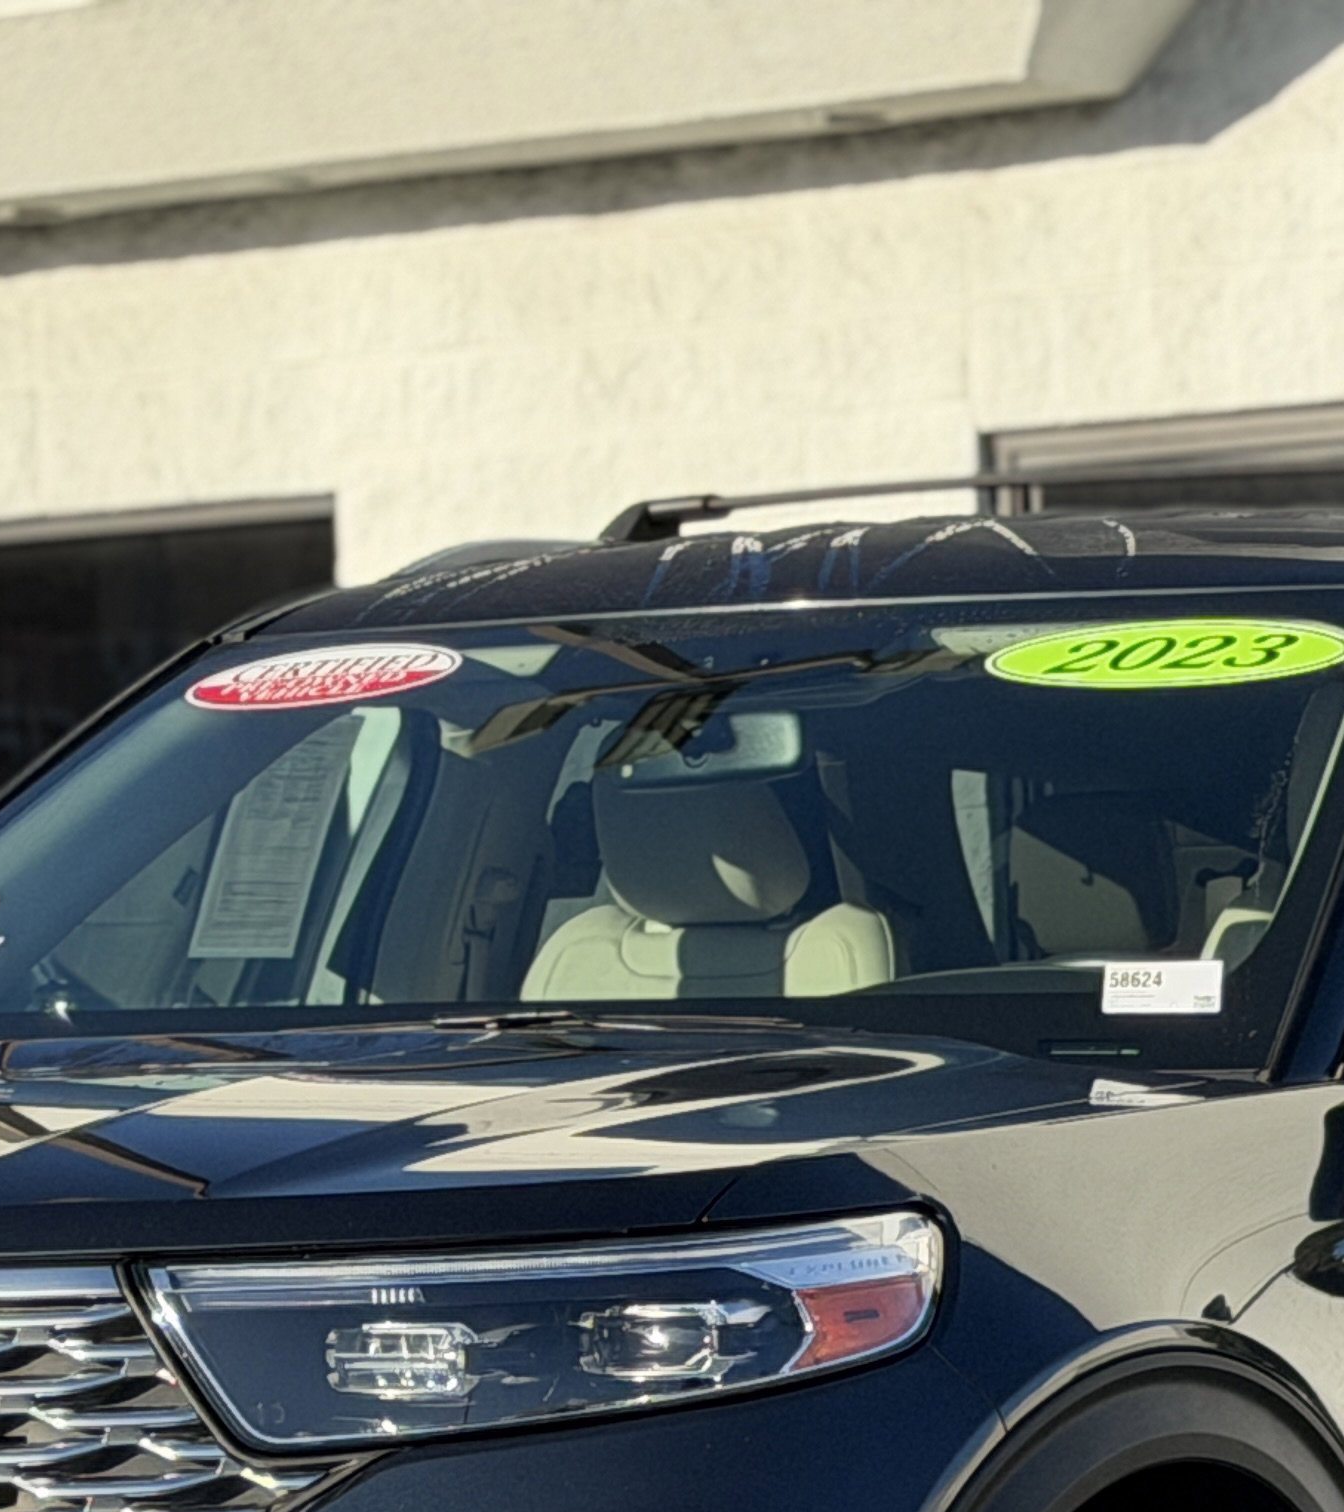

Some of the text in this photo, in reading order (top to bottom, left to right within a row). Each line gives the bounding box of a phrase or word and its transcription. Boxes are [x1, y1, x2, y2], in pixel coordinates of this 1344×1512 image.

[232, 653, 439, 684] CERTIFIED
[1042, 633, 1300, 675] 2023
[1109, 971, 1163, 988] 58624
